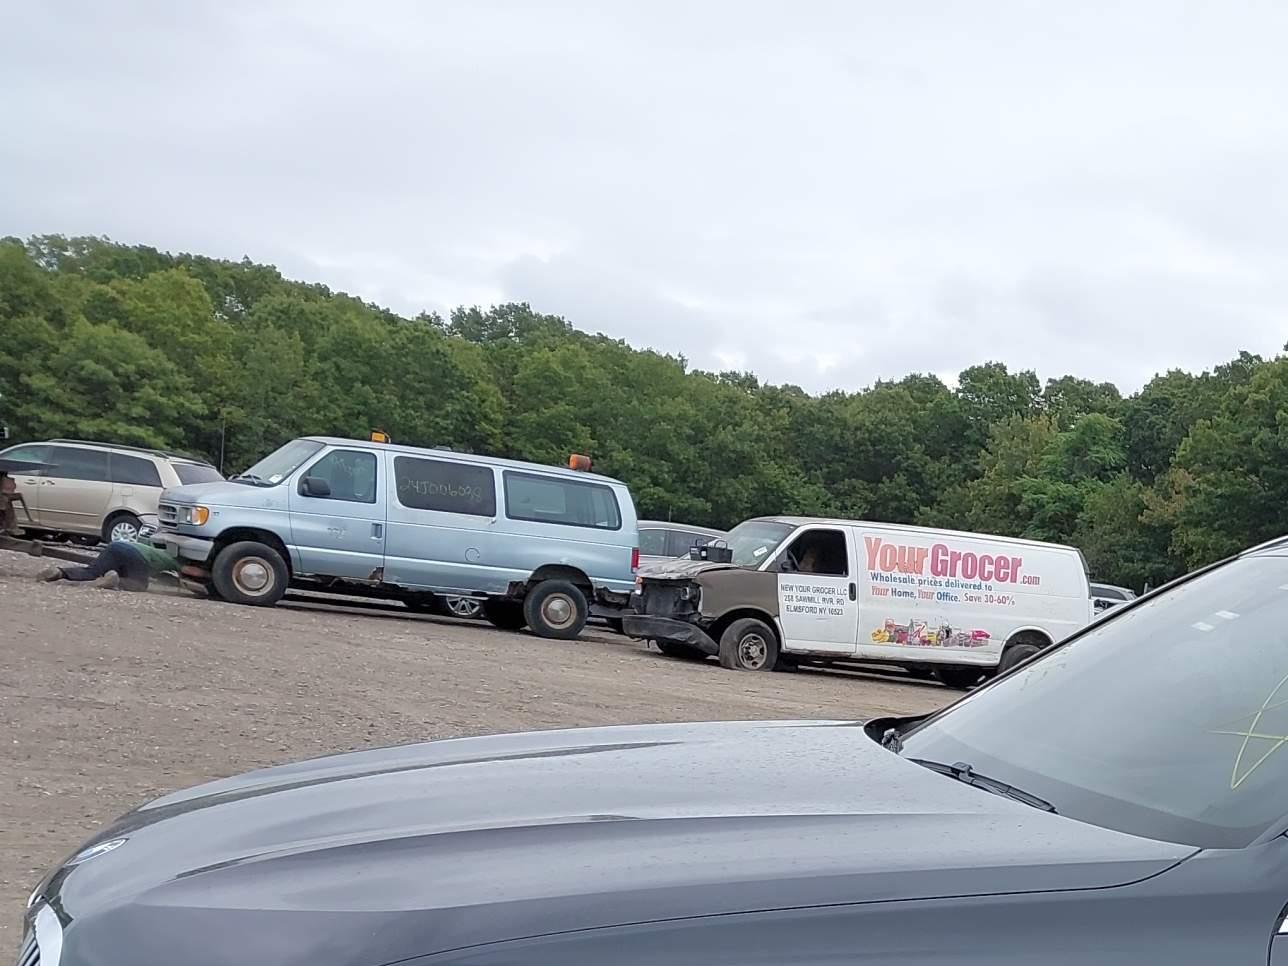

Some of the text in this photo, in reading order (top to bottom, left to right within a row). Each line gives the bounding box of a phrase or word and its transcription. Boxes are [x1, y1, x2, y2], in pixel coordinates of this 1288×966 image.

[871, 572, 915, 584] Wholesale
[918, 577, 942, 589] prices
[944, 578, 982, 590] delivered
[781, 584, 847, 596] NEW YOUR GROCER LLC
[872, 585, 1015, 606] Your Home, Your Office. Save 30-60%
[795, 595, 820, 604] SAWMILL
[786, 605, 817, 614] ELMSFORD
[819, 607, 827, 615] NY
